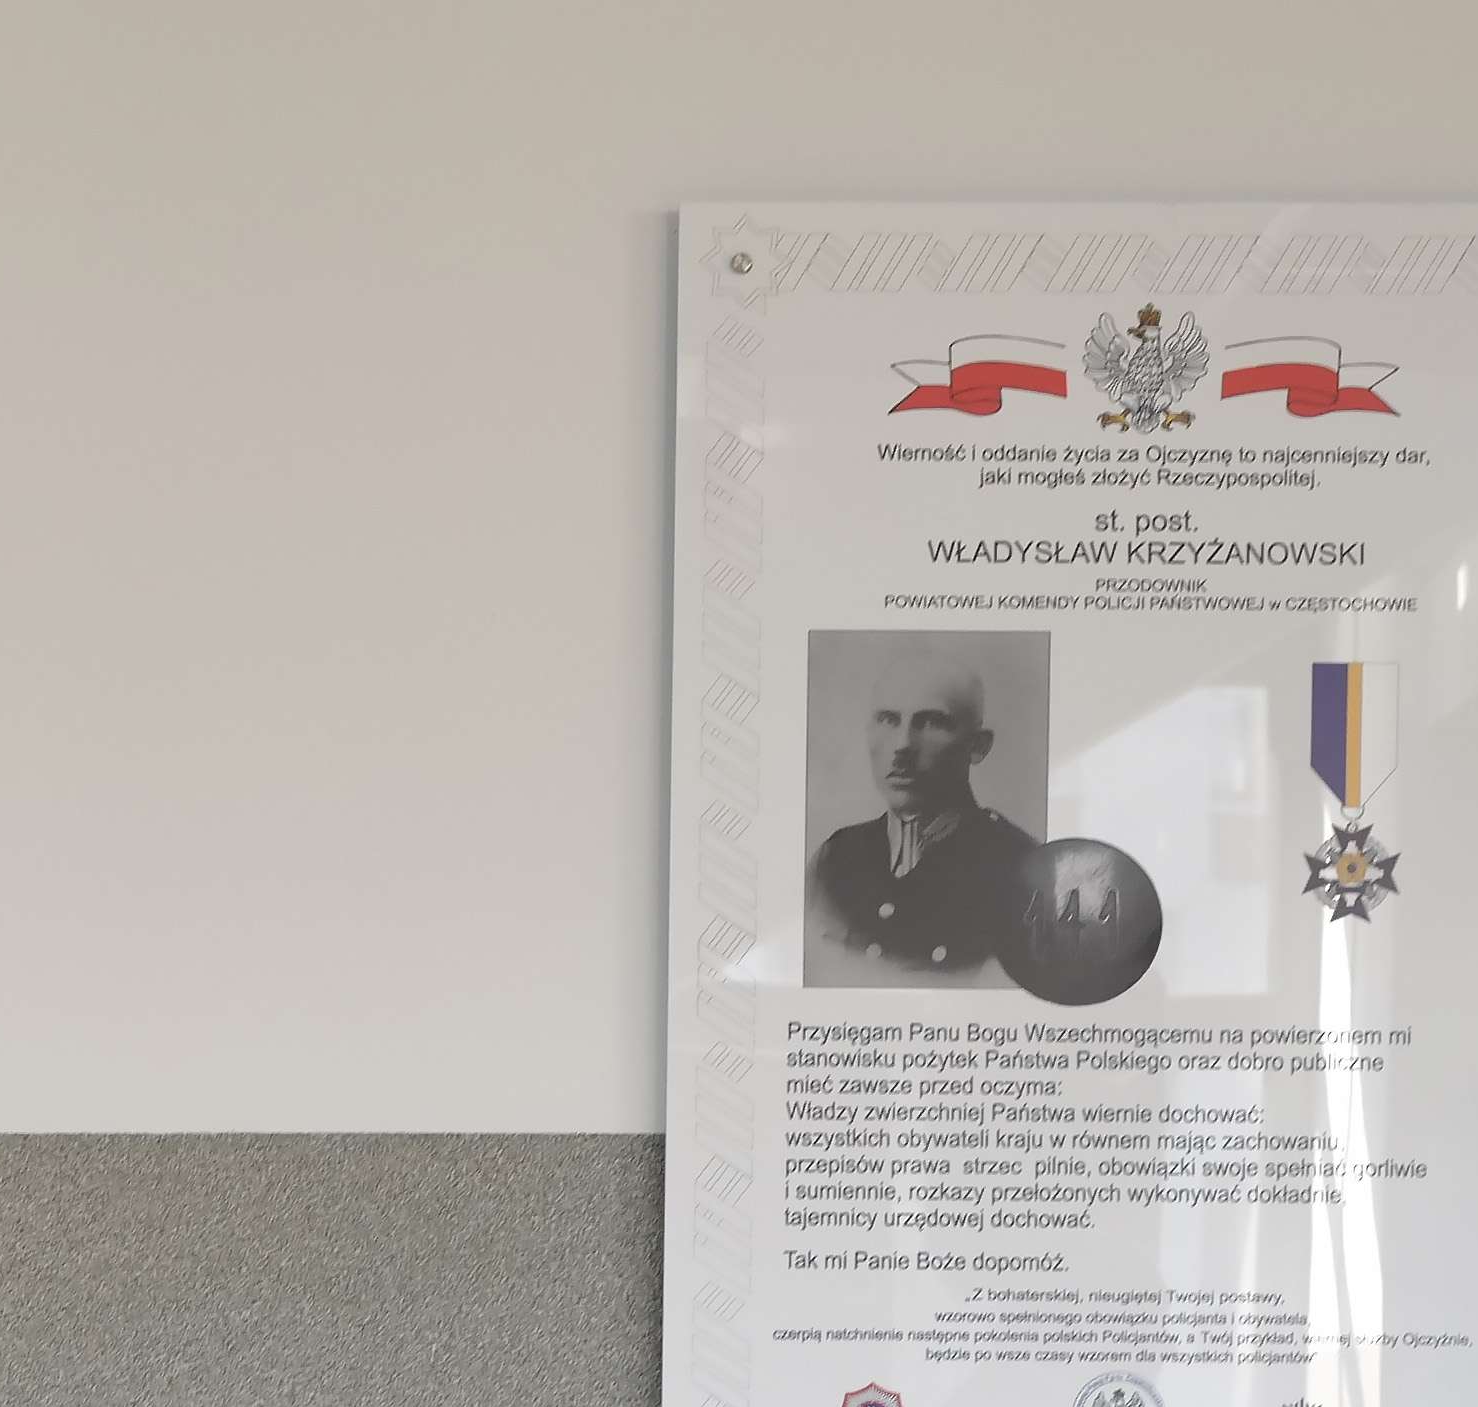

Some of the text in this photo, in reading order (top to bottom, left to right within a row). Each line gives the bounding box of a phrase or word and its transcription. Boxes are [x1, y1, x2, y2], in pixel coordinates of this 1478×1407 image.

[878, 444, 966, 462] Wierność
[982, 444, 1057, 462] oddanie
[1063, 445, 1110, 468] życia
[1117, 448, 1139, 462] za
[1146, 444, 1232, 469] Ojczyznę
[1239, 447, 1256, 463] to
[1262, 446, 1389, 469] najcenniejszy
[1396, 447, 1429, 466] dar,
[980, 466, 1320, 489] jaki mogłeś złożyć Rzeczypospolitej.
[1096, 509, 1197, 537] st. post.
[928, 537, 1364, 565] WŁADYSŁAW KRZYŻANOWSKI
[1096, 578, 1207, 593] PRZODOWNIK
[885, 595, 993, 610] POWIATOWEJ
[998, 595, 1079, 610] KOMENDY
[1084, 594, 1145, 610] POLICJI
[1150, 593, 1264, 611] PAŃSTWOWEJ
[1286, 596, 1416, 612] CZĘSTOCHOWIE
[788, 1022, 902, 1046] Przysięgam
[910, 1022, 959, 1042] Panu
[967, 1022, 1017, 1046] Bogu
[1025, 1024, 1212, 1048] Wszechmogącemu
[1220, 1029, 1243, 1044] na
[1389, 1025, 1411, 1044] mi
[788, 1048, 895, 1069] stanowisku
[903, 1049, 978, 1071] pożytek
[985, 1048, 1068, 1069] Państwa
[1077, 1047, 1172, 1073] Polskiego
[1178, 1055, 1221, 1070] oraz
[1228, 1050, 1284, 1070] dobro
[787, 1075, 833, 1094] mieć
[839, 1080, 912, 1094] zawsze
[919, 1075, 973, 1097] przed
[787, 1101, 858, 1125] Władzy
[864, 1101, 984, 1124] zwierzchniej
[992, 1101, 1075, 1123] Państwa
[1082, 1104, 1152, 1123] wiernie
[786, 1127, 890, 1151] wszystkich
[897, 1128, 989, 1152] obywateli
[996, 1127, 1043, 1152] kraju
[1072, 1129, 1150, 1150] równem
[1157, 1130, 1216, 1154] mając
[786, 1154, 884, 1177] przepisów
[891, 1160, 950, 1178] prawa
[964, 1156, 1022, 1176] strzec
[1035, 1156, 1091, 1179] pilnie,
[1099, 1155, 1195, 1179] obowiązki
[1203, 1156, 1258, 1181] swoje
[796, 1180, 901, 1209] sumiennie,
[909, 1181, 984, 1207] rozkazy
[991, 1181, 1120, 1208] przełożonych
[1128, 1181, 1241, 1206] wykonywać
[785, 1207, 1094, 1231] tajemnicy urzędowej dochować.
[784, 1250, 1068, 1274] Tak mi Panie Boże dopomóż.
